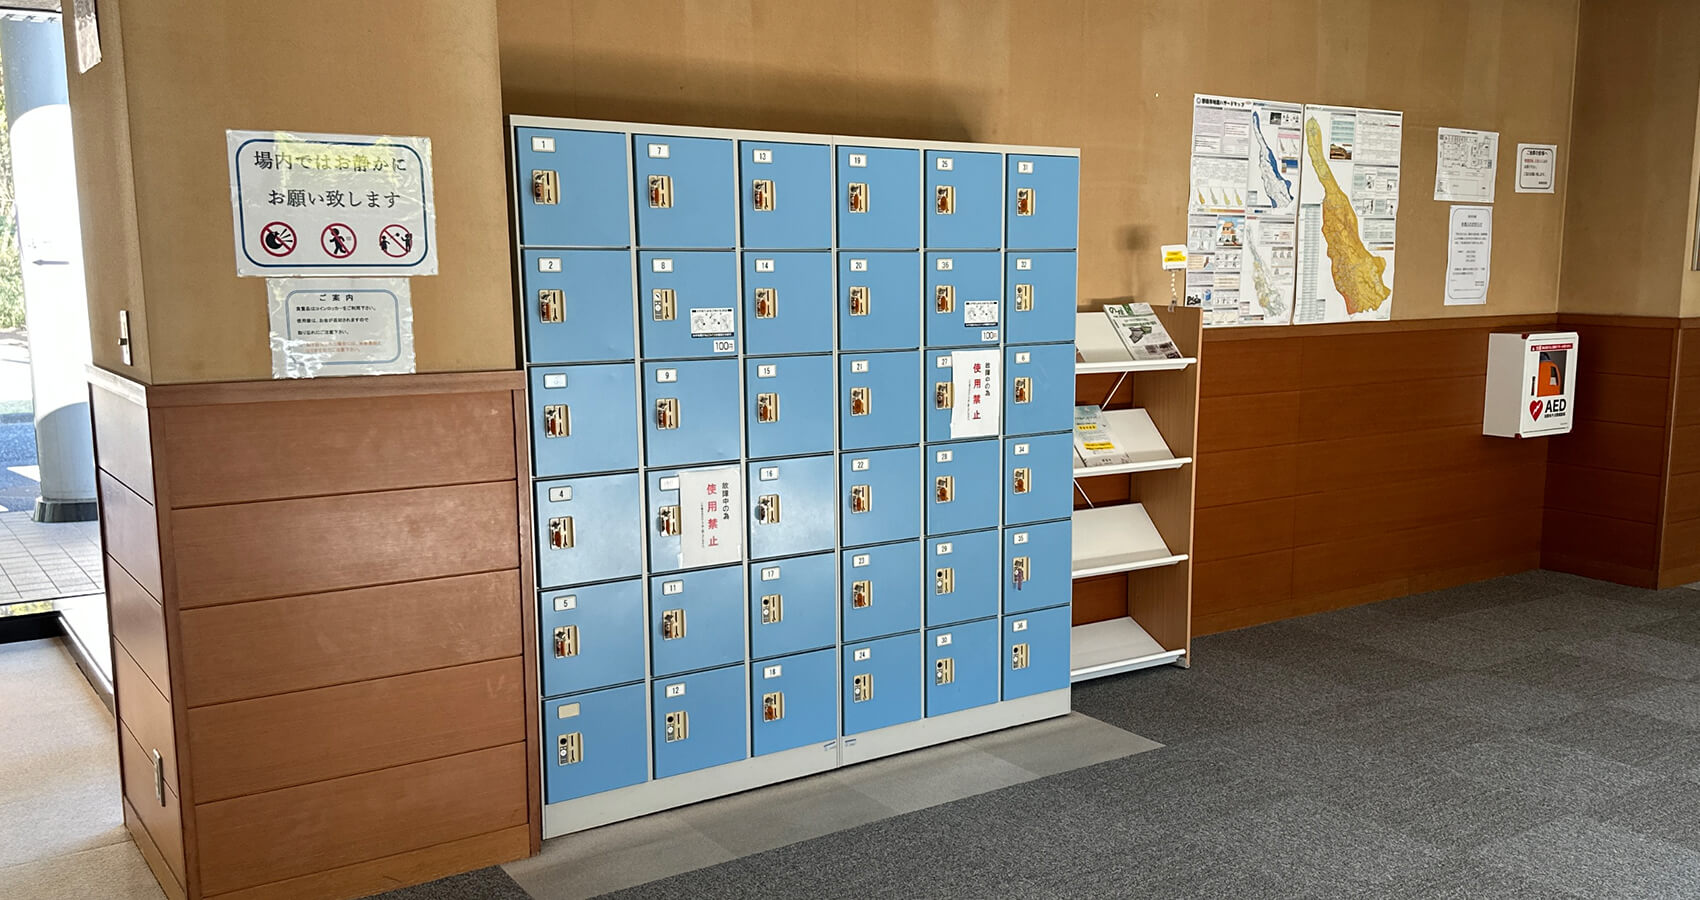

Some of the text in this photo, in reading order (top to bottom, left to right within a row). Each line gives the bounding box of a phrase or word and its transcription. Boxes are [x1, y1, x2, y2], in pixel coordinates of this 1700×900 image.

[254, 150, 407, 172] 場内ではお静かに
[268, 188, 400, 209] お願い致します
[319, 294, 354, 302] ご案内
[973, 363, 981, 420] 使用禁止
[1544, 398, 1567, 413] AED
[721, 482, 730, 520] 故障中の為
[706, 483, 719, 547] 使用禁止
